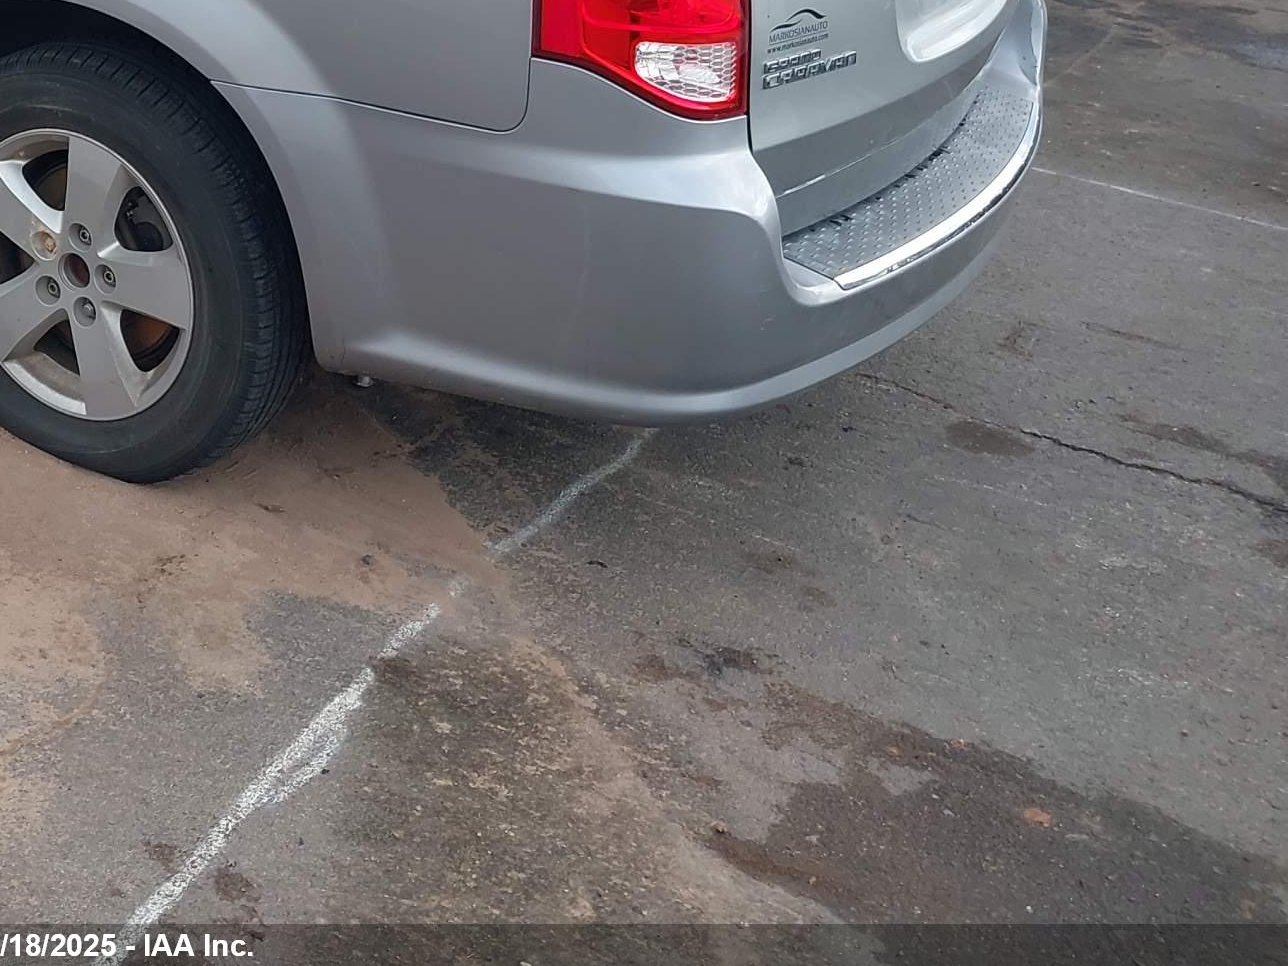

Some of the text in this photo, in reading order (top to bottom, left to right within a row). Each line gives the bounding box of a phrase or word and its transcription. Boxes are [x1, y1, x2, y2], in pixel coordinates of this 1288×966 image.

[768, 21, 829, 43] MARKOSIANAUTO
[762, 51, 857, 90] CARAVAN
[763, 48, 822, 74] GRAND
